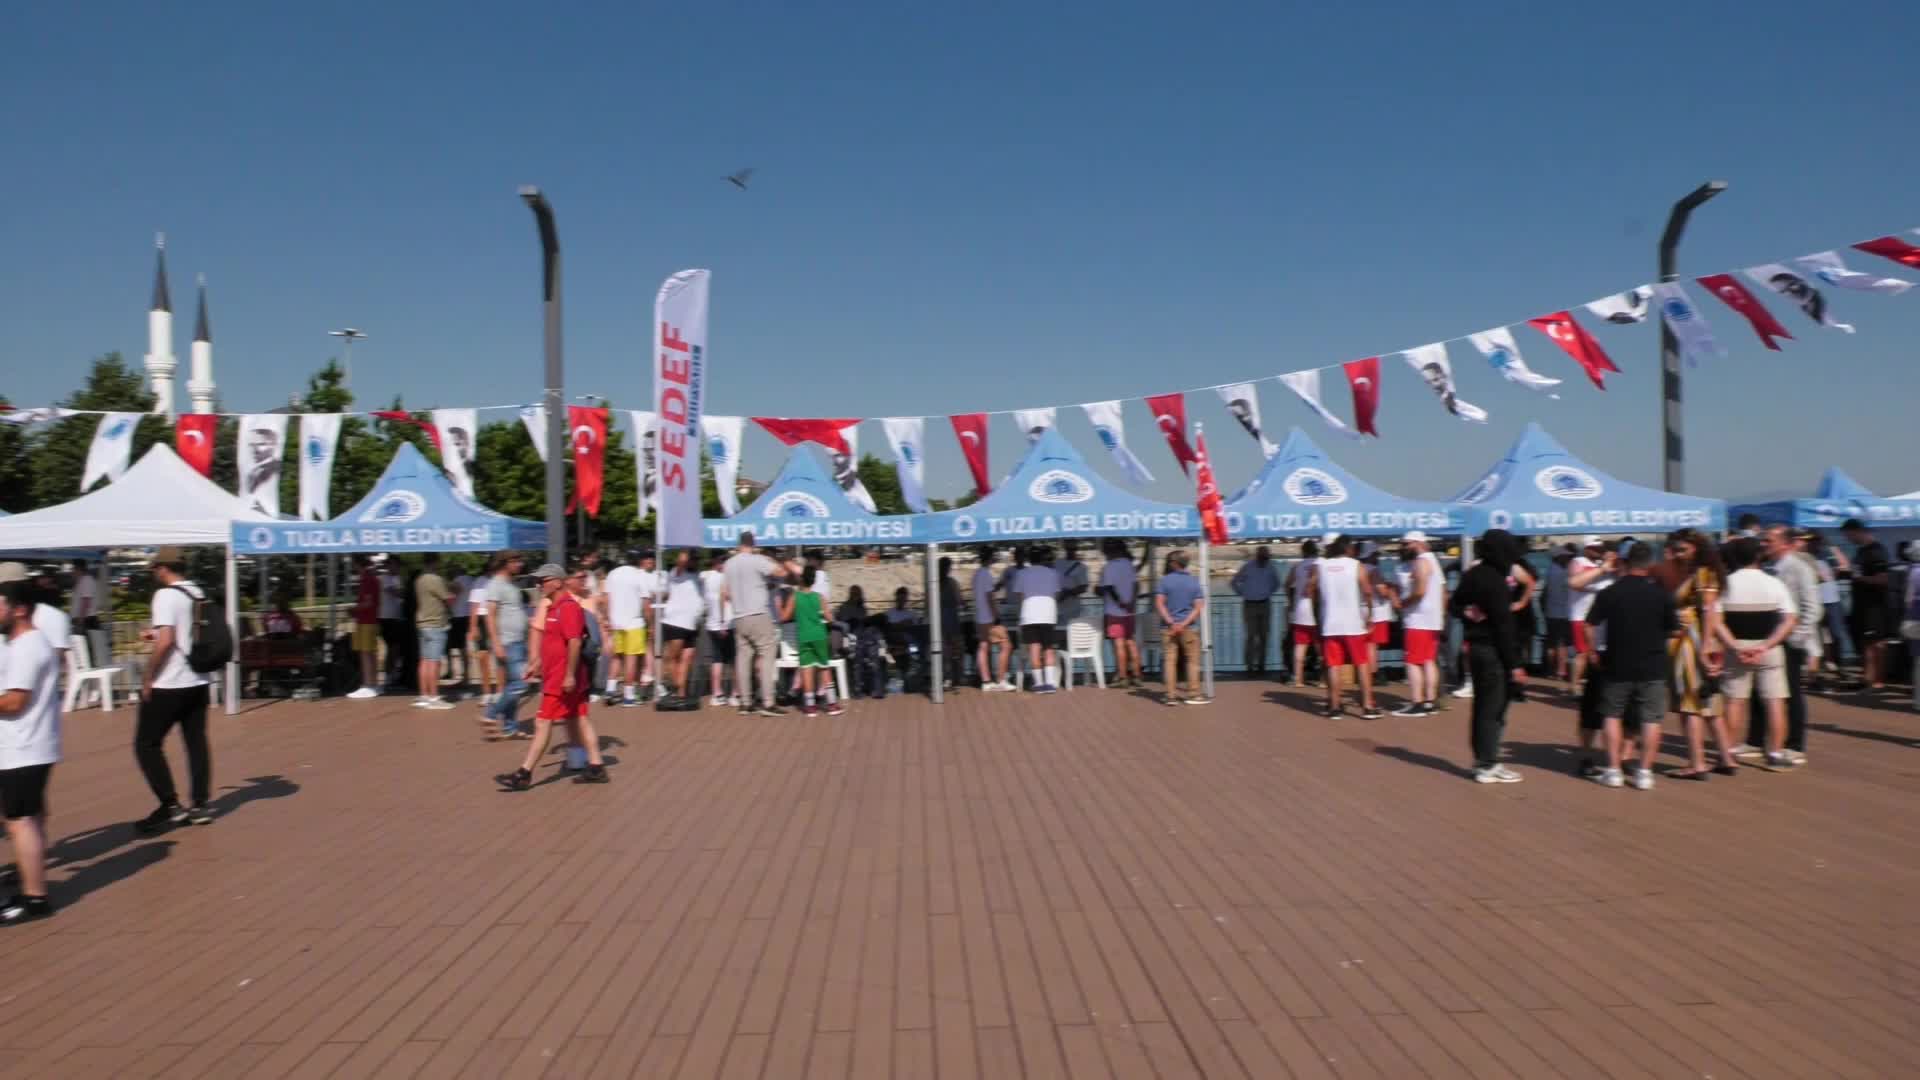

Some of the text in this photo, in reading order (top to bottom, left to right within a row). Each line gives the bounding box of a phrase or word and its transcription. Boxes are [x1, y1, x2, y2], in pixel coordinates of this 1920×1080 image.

[661, 321, 689, 496] SEDEF
[783, 517, 912, 539] BELEDİYESİ
[986, 509, 1188, 535] TUZLA BELEDİYESİ
[1256, 508, 1450, 531] TUZLA BELEDİYESİ
[282, 524, 491, 547] TUZLA BELEDİYESİ
